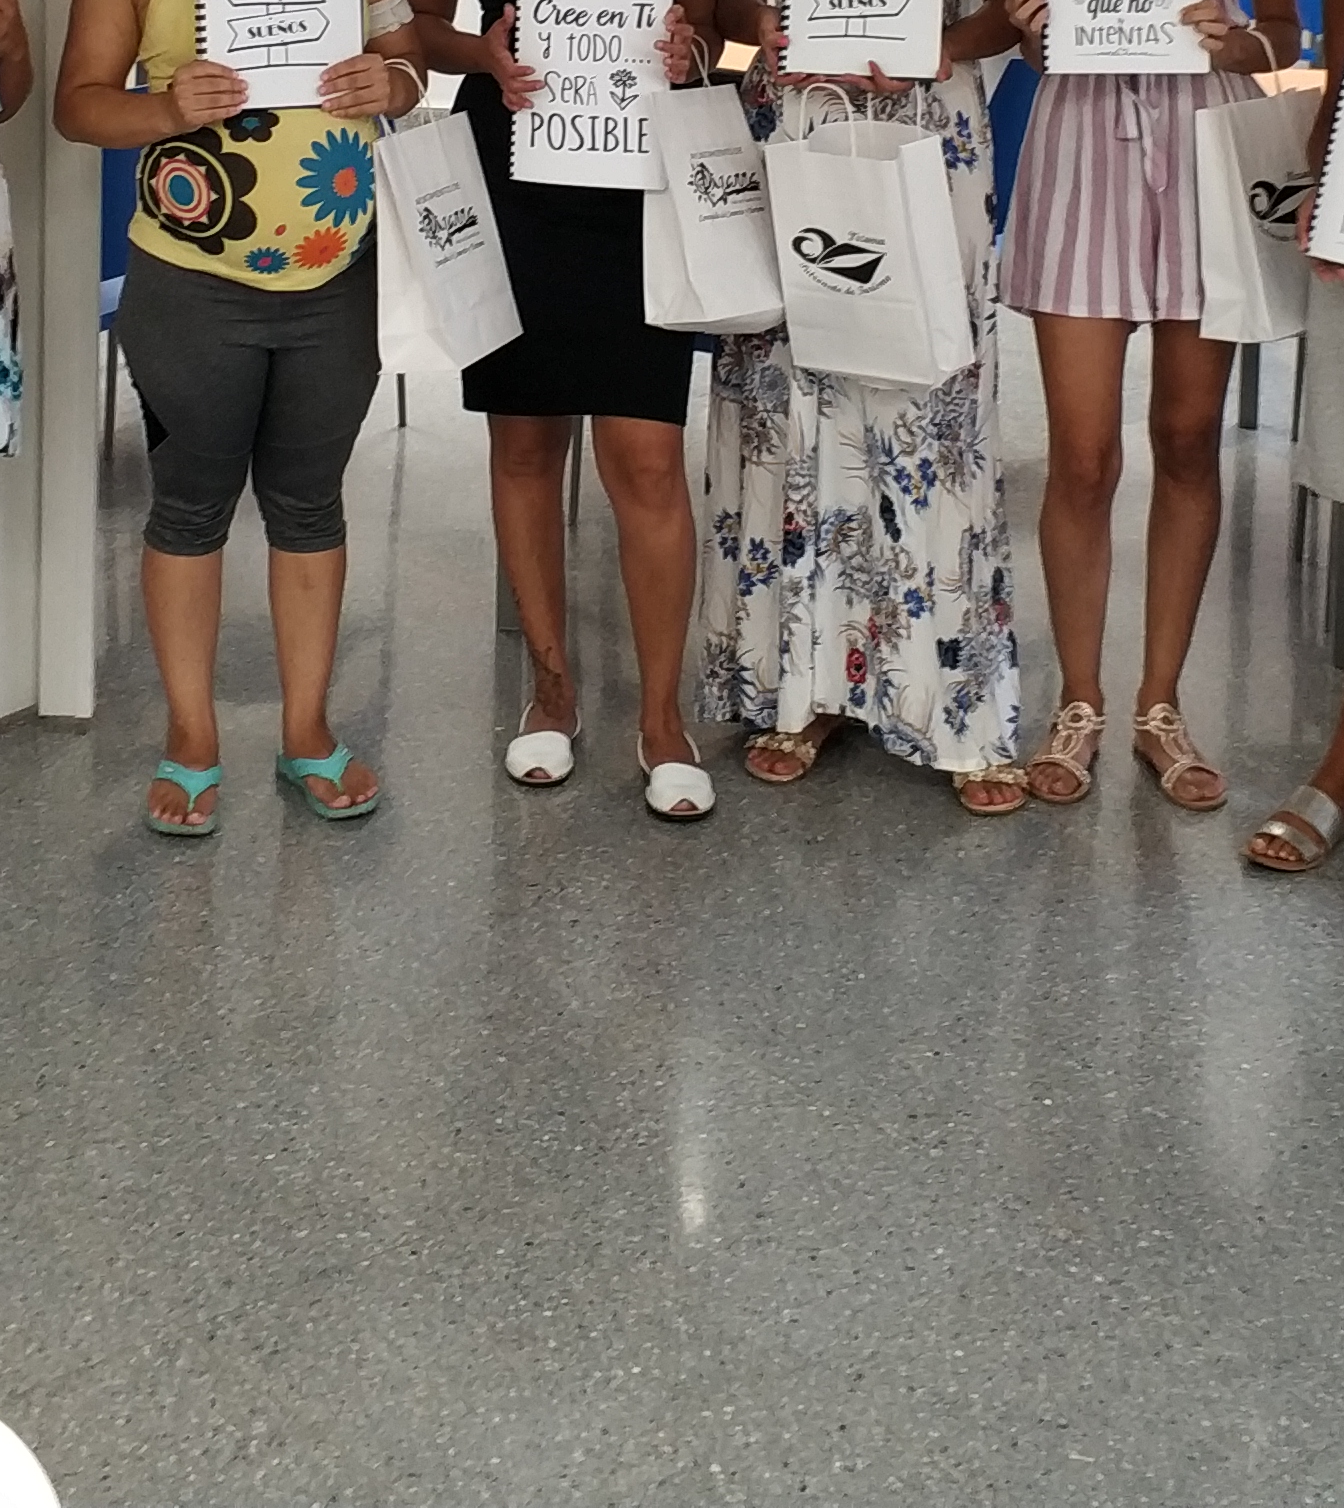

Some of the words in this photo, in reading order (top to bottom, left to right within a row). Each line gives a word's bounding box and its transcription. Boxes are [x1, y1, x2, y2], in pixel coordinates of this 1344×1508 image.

[247, 19, 308, 39] SUEÑOS
[596, 8, 629, 29] en
[529, 112, 650, 154] POSIBLE
